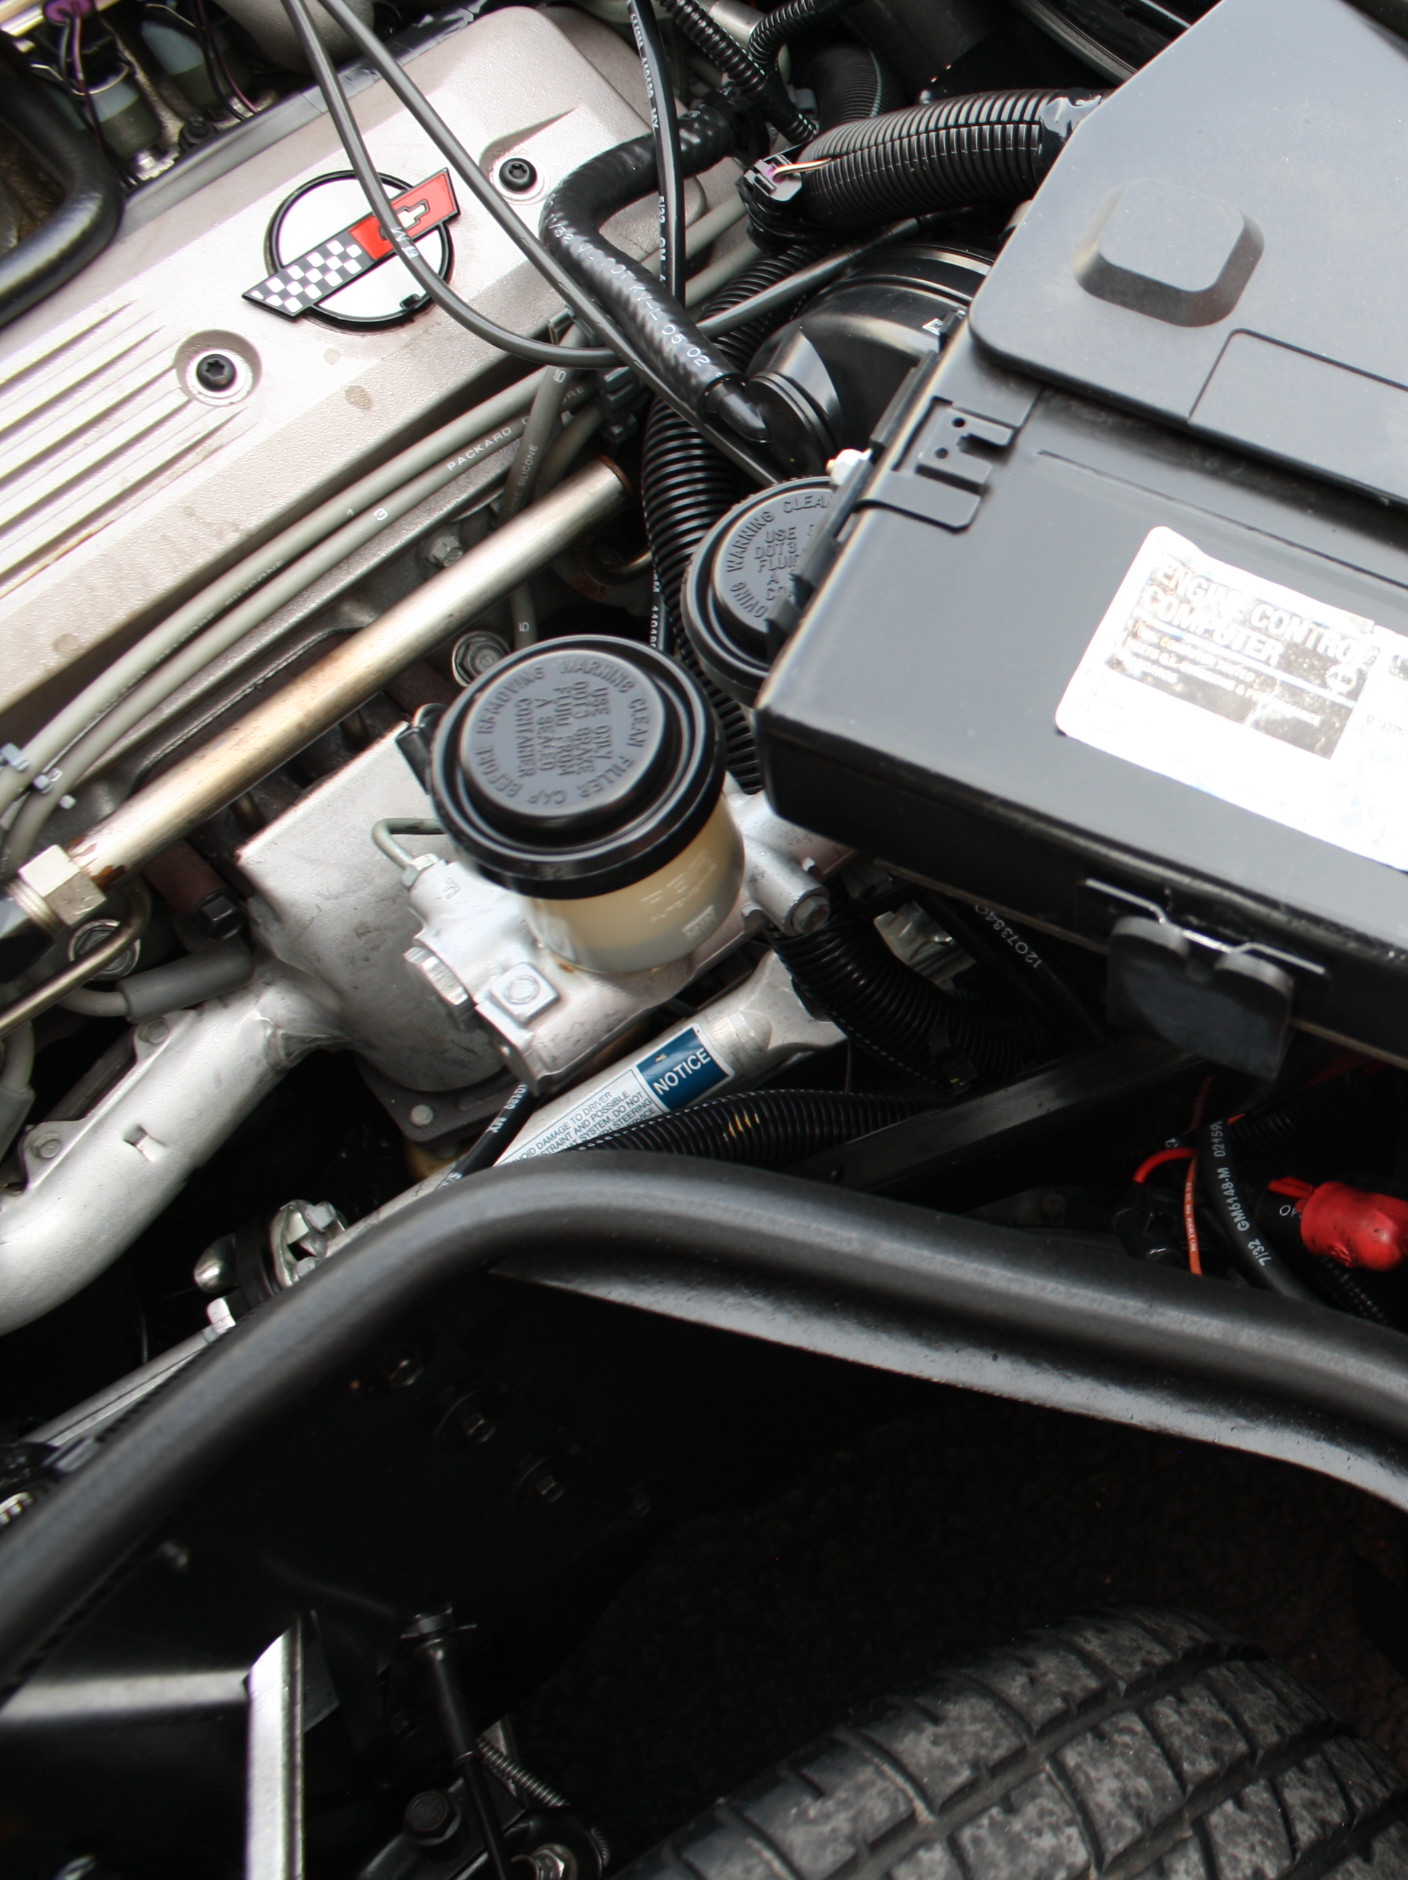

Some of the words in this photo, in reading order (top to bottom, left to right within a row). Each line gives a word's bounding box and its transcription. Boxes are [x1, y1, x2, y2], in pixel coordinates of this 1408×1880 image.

[686, 346, 711, 368] 02
[446, 426, 513, 471] PACKARD
[517, 443, 539, 487] SILICONE
[726, 510, 775, 573] WARNING
[783, 494, 830, 514] CLEA
[765, 526, 798, 544] USE
[729, 581, 769, 618] OVING
[1148, 584, 1285, 668] COMPUTER
[559, 657, 635, 694] WARNING
[475, 666, 546, 735] REMOVING
[552, 685, 574, 727] FLUID
[589, 686, 611, 716] USE
[536, 715, 556, 772] SEALED
[592, 724, 614, 760] ONLY
[626, 697, 650, 749] CLEAN
[474, 746, 525, 798] BEFORE
[555, 736, 576, 776] FROM
[574, 726, 596, 776] BRAKE
[527, 789, 567, 806] CAP
[576, 754, 635, 799] FILLER
[652, 1046, 712, 1096] NOTICE
[516, 1145, 538, 1162] VOID
[535, 1121, 572, 1152] DAMAGE
[571, 1113, 584, 1126] TO
[582, 1090, 614, 1116] DRIVER
[538, 1132, 572, 1158] STRAINT
[573, 1118, 592, 1136] AND
[589, 1089, 631, 1123] POSSIBLE
[613, 1106, 627, 1120] DO
[625, 1090, 645, 1112] NOT
[613, 1097, 653, 1130] STEERING
[1216, 1166, 1250, 1232] GM6148-M
[1247, 1238, 1272, 1267] 7/32
